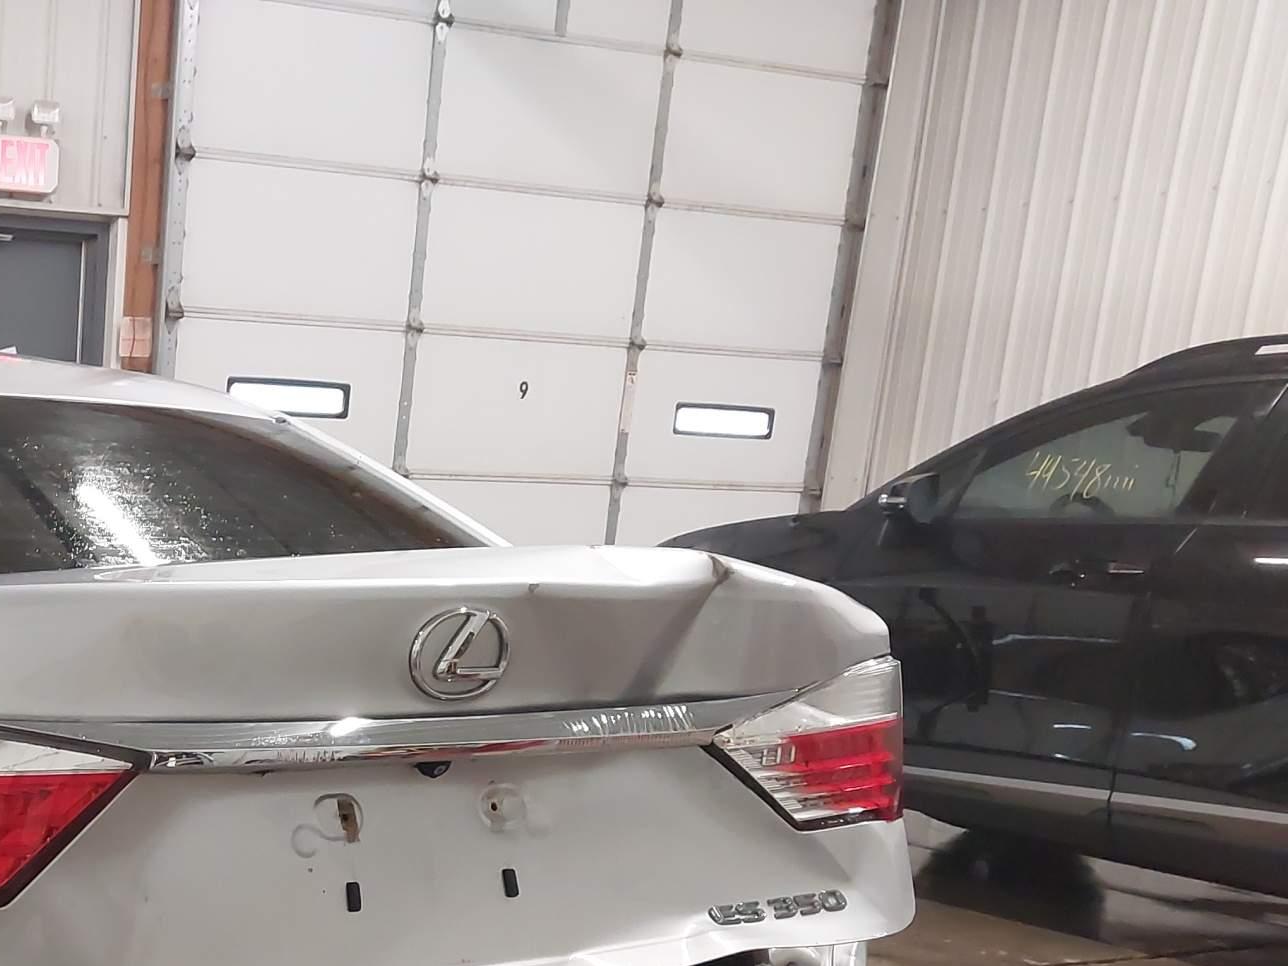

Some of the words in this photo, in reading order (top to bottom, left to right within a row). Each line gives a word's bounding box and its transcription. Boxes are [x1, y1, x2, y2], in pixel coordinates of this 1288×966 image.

[0, 140, 49, 185] EXIT
[519, 381, 529, 399] 9
[708, 901, 767, 925] ES
[767, 889, 848, 920] 350
